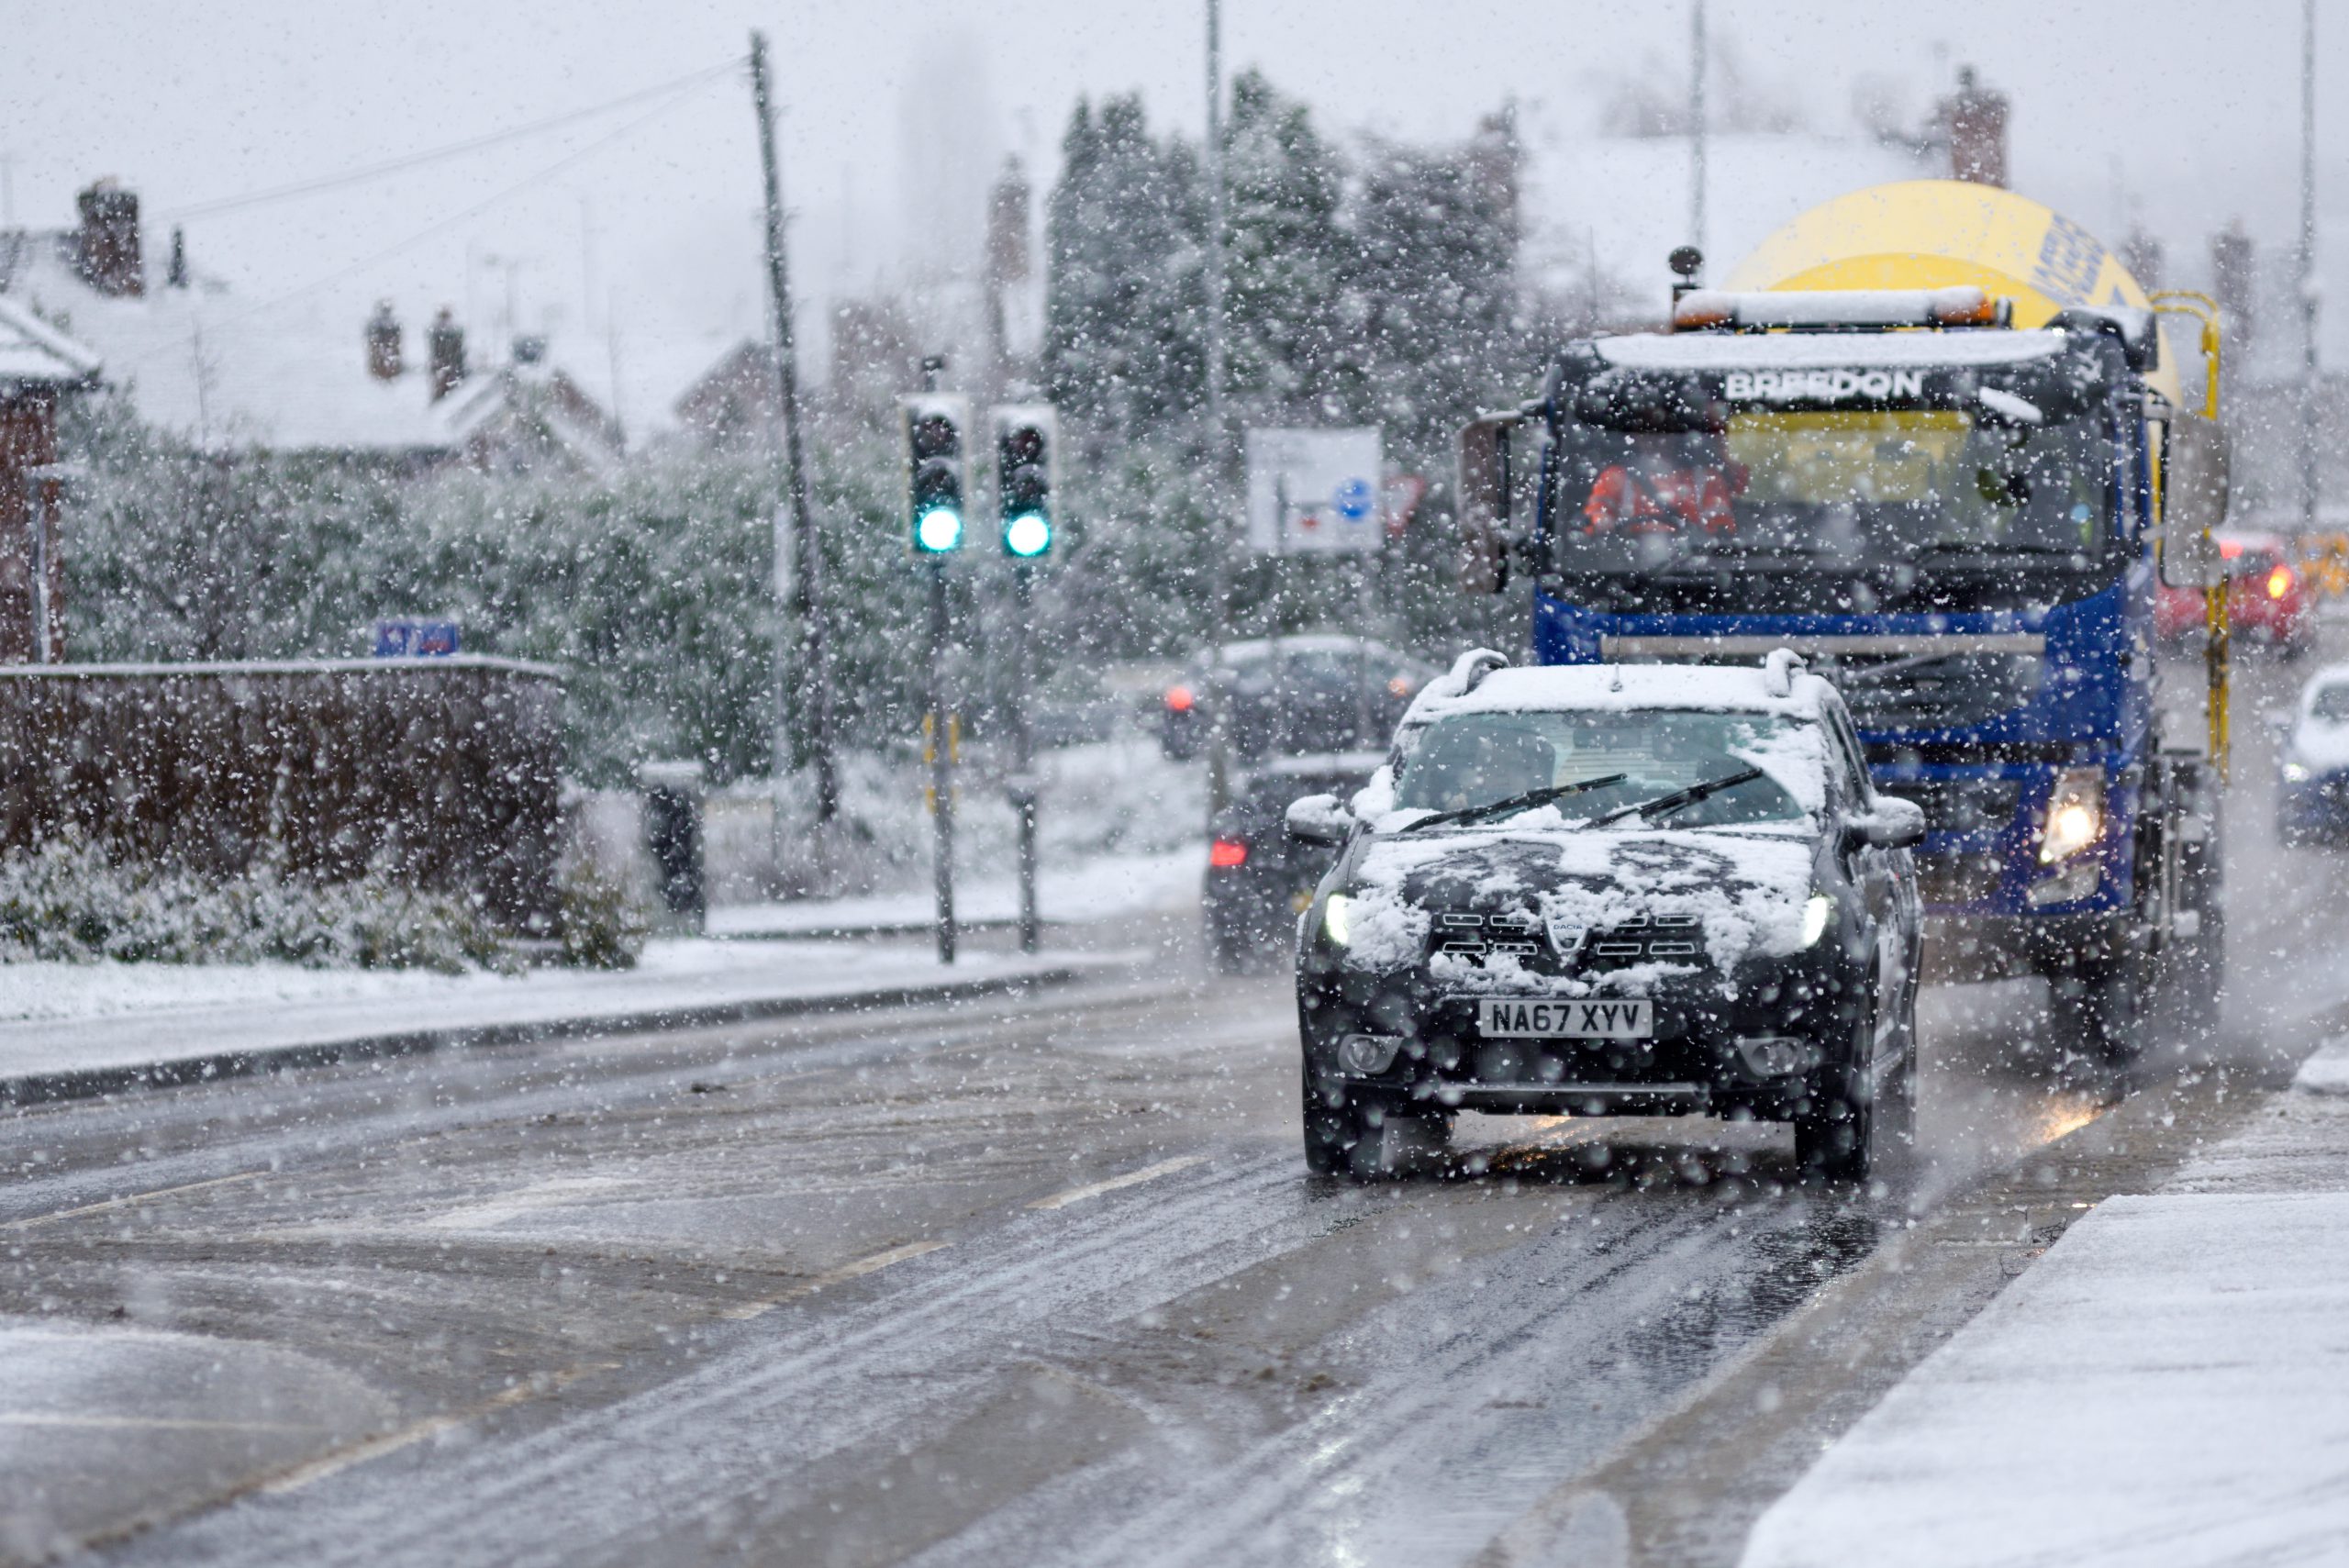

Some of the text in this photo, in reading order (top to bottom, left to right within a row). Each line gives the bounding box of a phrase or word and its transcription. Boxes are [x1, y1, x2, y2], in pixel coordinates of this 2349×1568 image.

[1725, 369, 1924, 400] BREEDON
[1492, 1004, 1640, 1032] NA67 XYV
